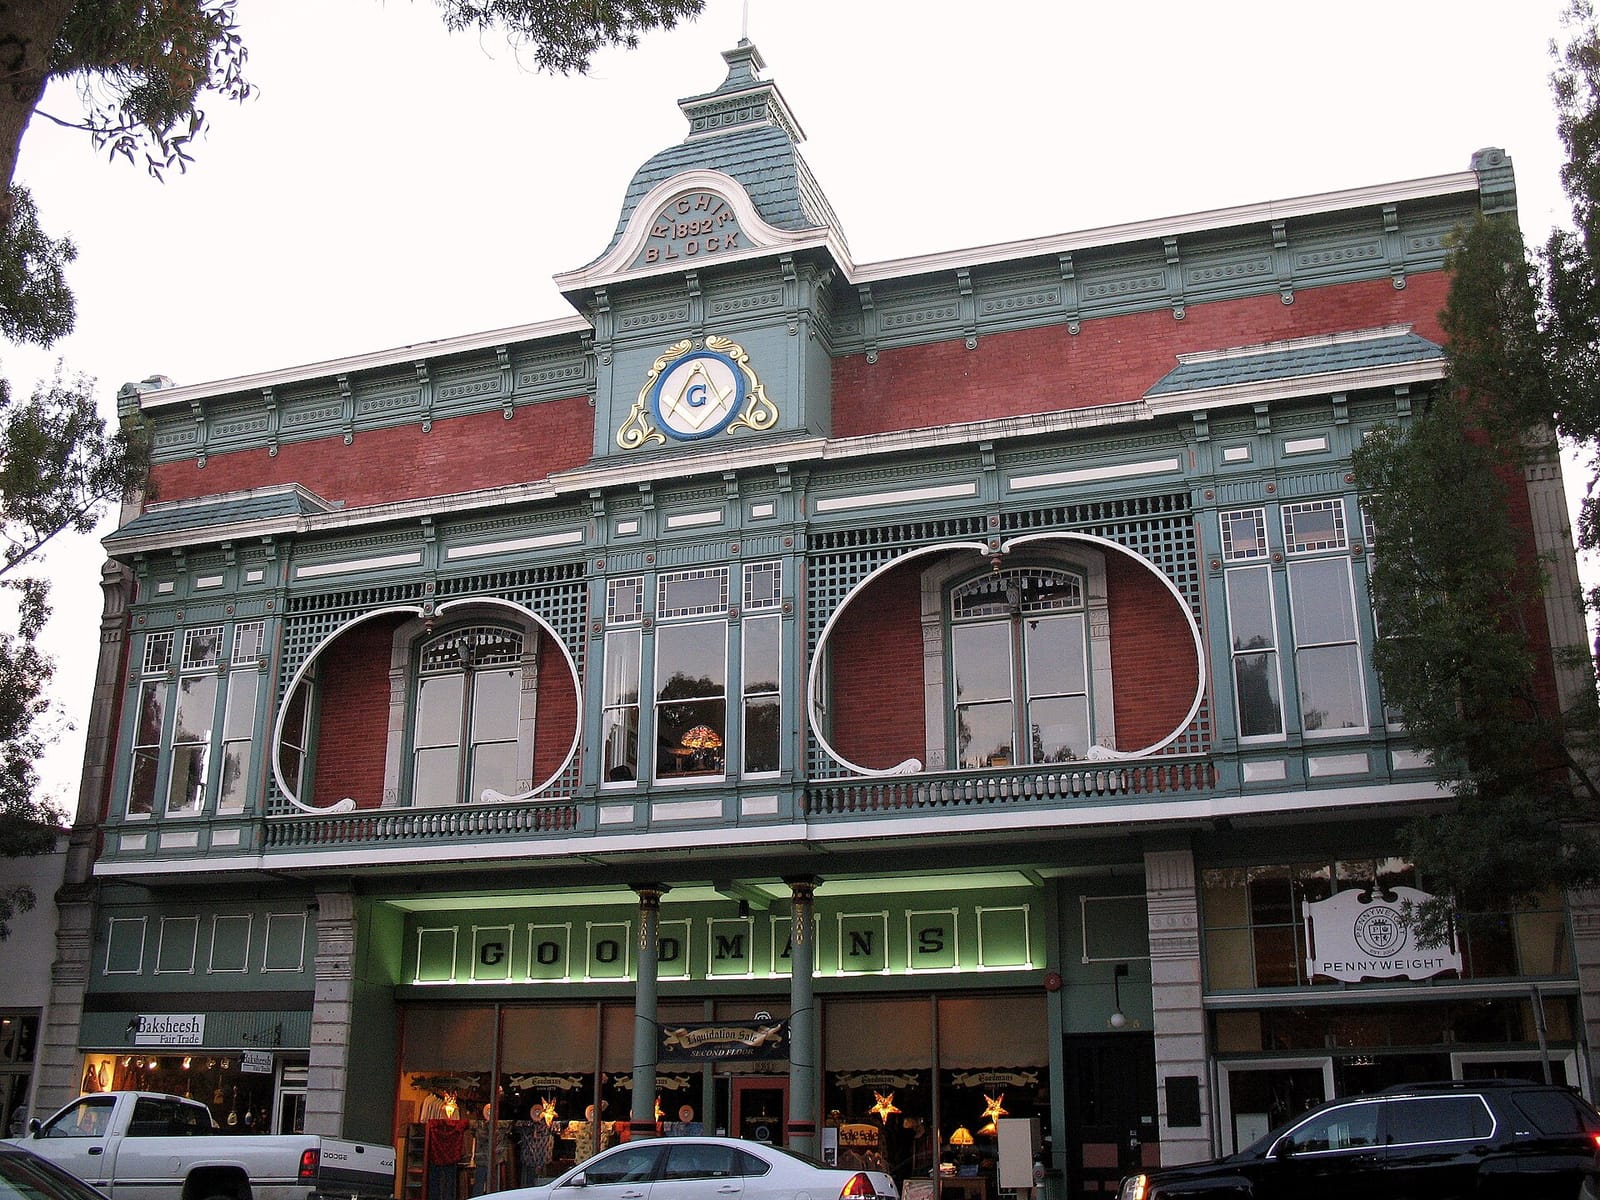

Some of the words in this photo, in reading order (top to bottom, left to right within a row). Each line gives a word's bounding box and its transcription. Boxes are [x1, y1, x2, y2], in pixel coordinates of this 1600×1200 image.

[650, 195, 735, 238] RICHIE
[671, 218, 714, 240] 1892
[645, 232, 739, 263] BLOCK
[686, 383, 707, 407] G
[1356, 907, 1405, 938] PENNYWEIGT
[1323, 959, 1444, 972] PENNYWEIGHT
[138, 1016, 200, 1033] Baksheesh
[160, 1035, 175, 1044] Fair
[177, 1035, 200, 1043] Trade
[686, 1030, 736, 1044] Liquidation
[738, 1030, 757, 1043] Sale
[690, 1049, 725, 1057] SECOND
[725, 1048, 755, 1056] FLOOR
[323, 1152, 347, 1160] DODGE
